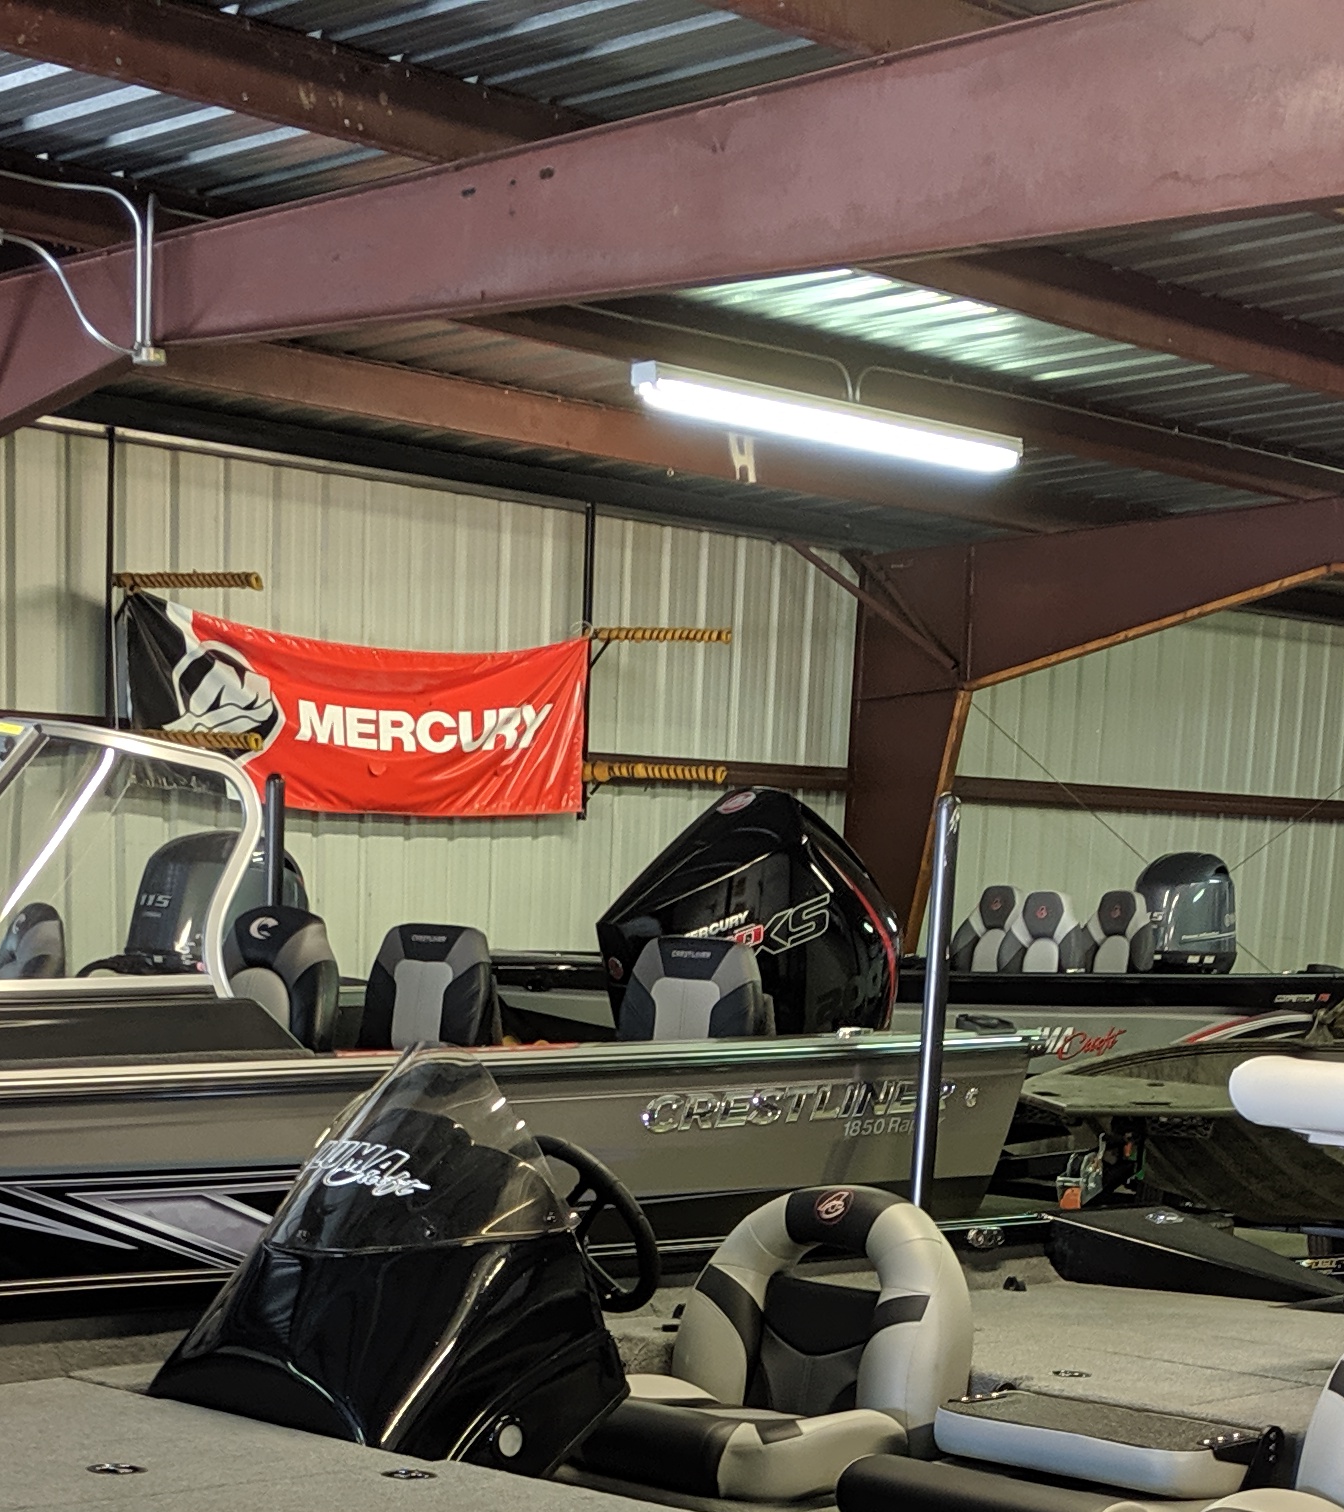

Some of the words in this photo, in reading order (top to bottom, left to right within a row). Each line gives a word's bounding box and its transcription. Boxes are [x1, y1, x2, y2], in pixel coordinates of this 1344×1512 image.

[295, 698, 554, 754] MERCURY
[140, 894, 172, 908] 115
[684, 910, 750, 938] ERCURY
[843, 1119, 885, 1137] 1850
